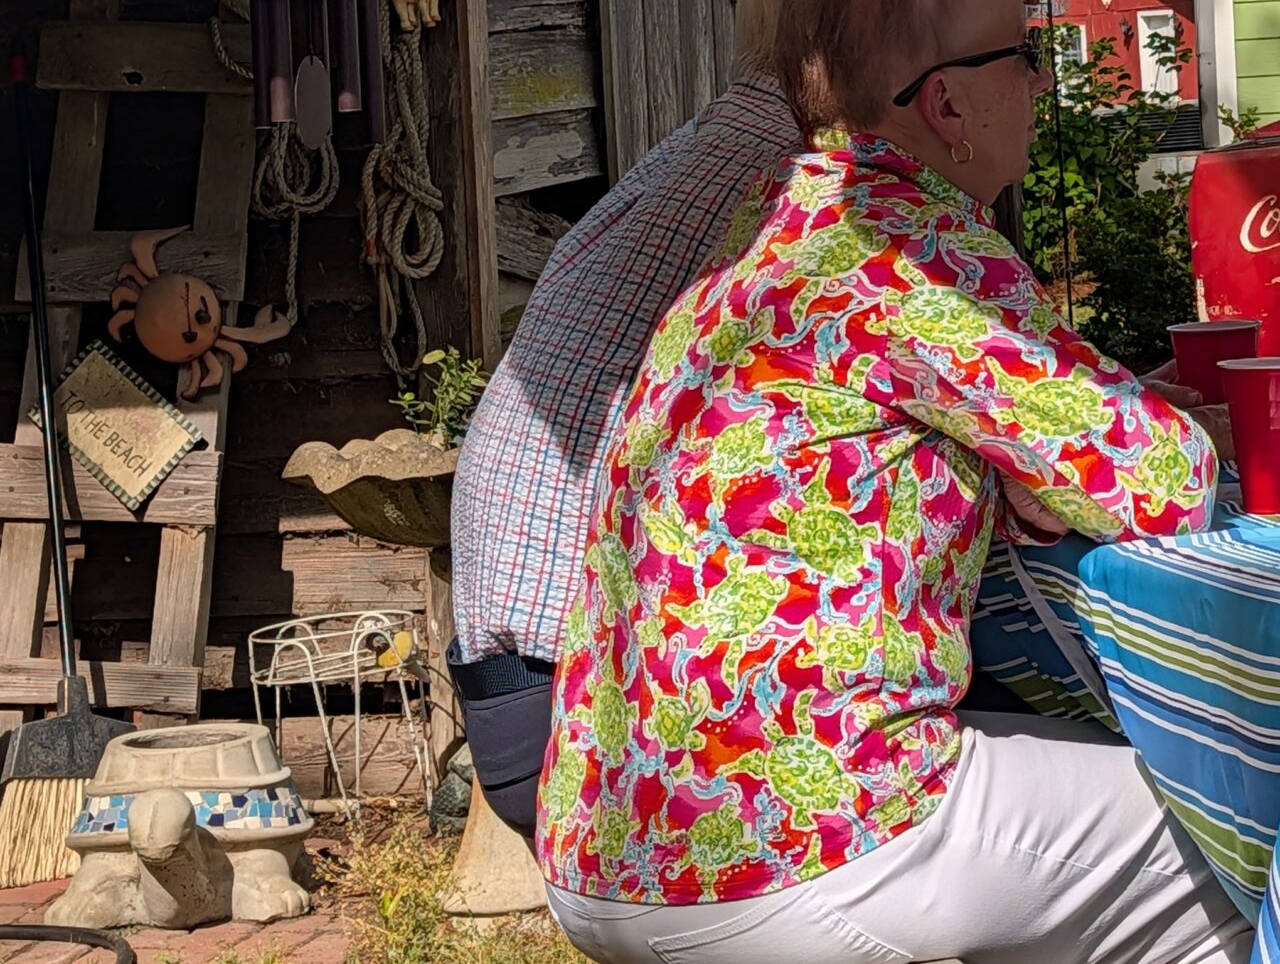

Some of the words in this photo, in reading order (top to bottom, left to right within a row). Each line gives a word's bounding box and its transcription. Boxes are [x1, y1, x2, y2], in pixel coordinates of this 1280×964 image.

[60, 390, 85, 415] TO
[80, 411, 108, 440] THE
[103, 431, 152, 478] BEACH
